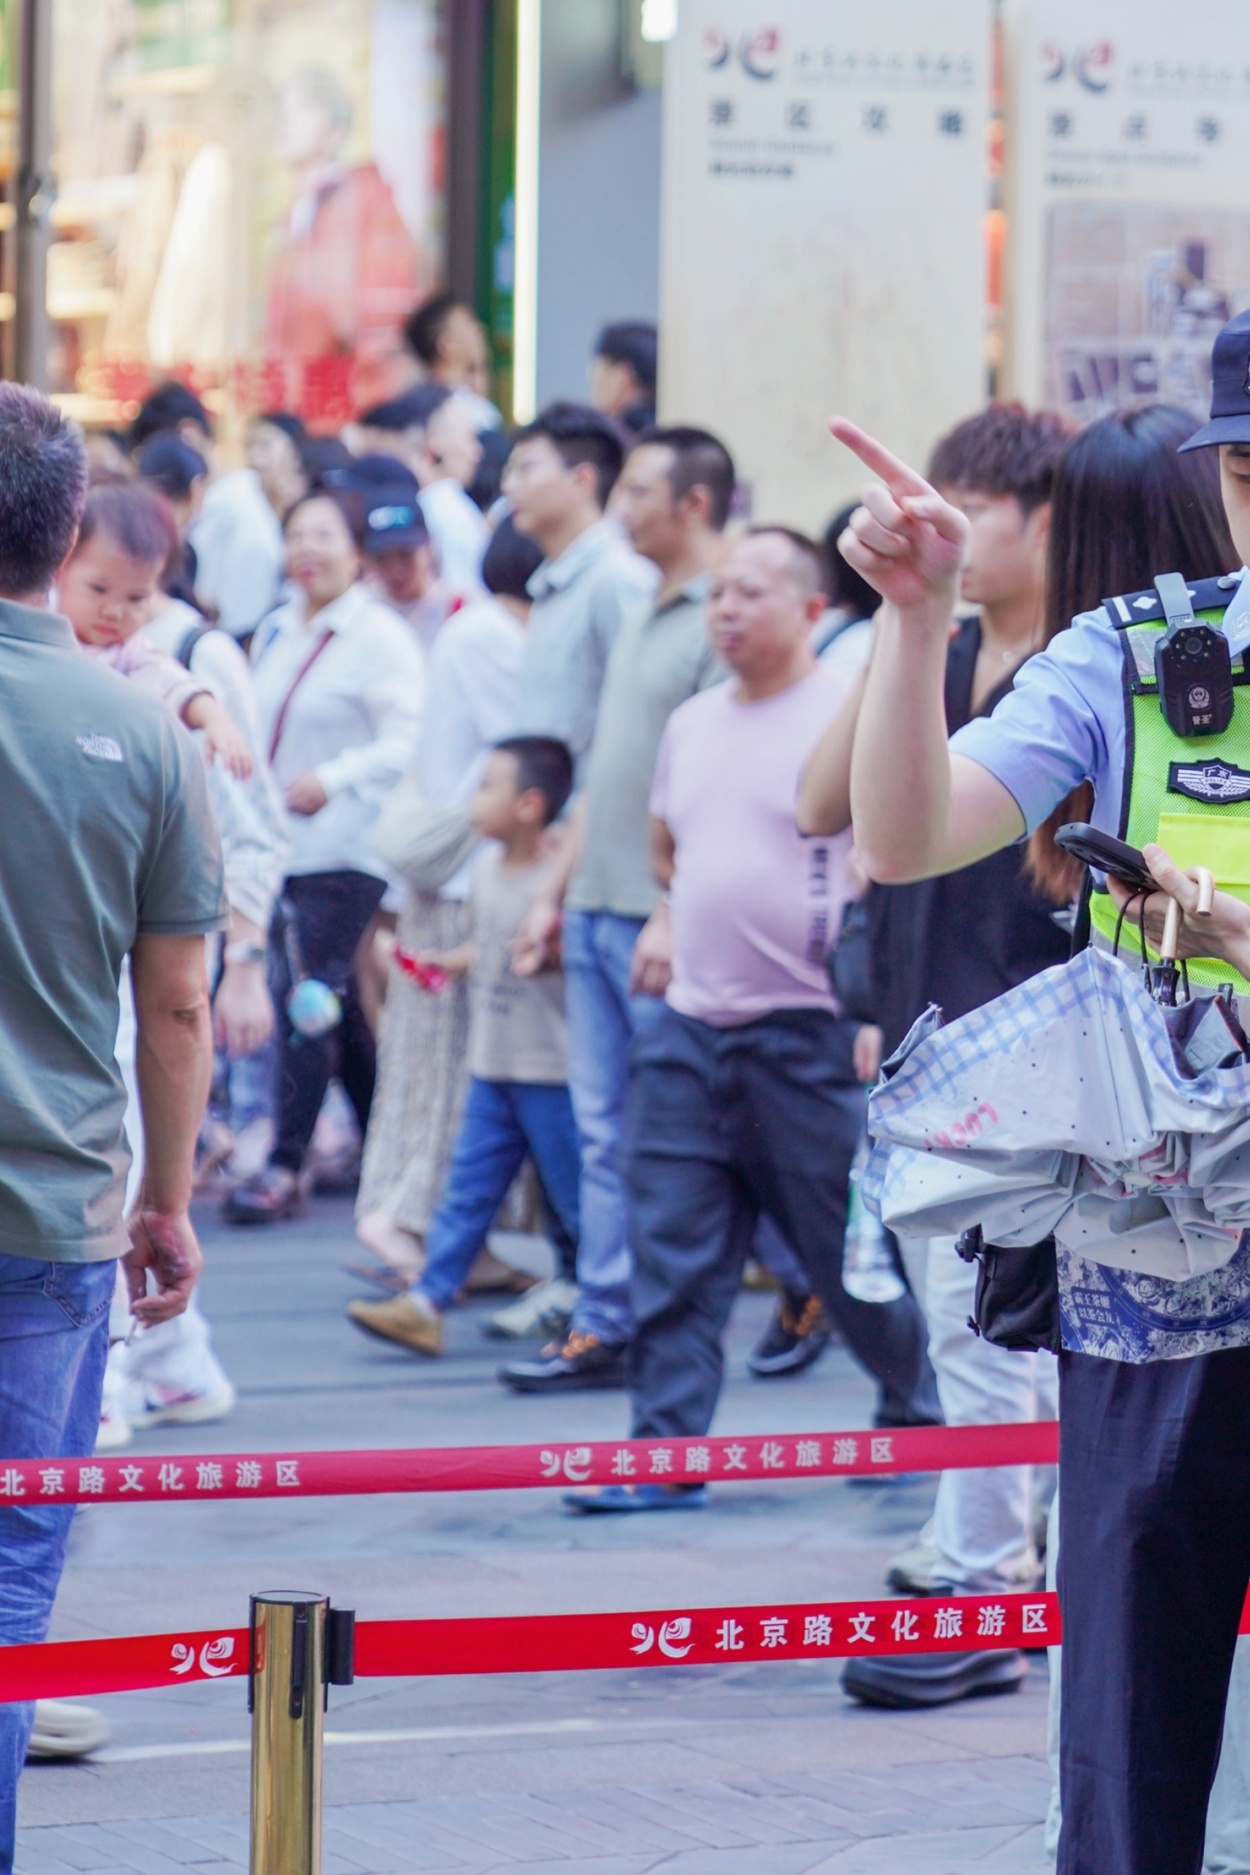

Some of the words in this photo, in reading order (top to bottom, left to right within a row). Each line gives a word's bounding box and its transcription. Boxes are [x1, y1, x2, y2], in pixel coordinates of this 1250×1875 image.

[610, 1437, 895, 1477] 北京路文化旅游区
[0, 1460, 302, 1496] 北京路文化旅游区
[714, 1603, 1048, 1651] 北京路文化旅游区
